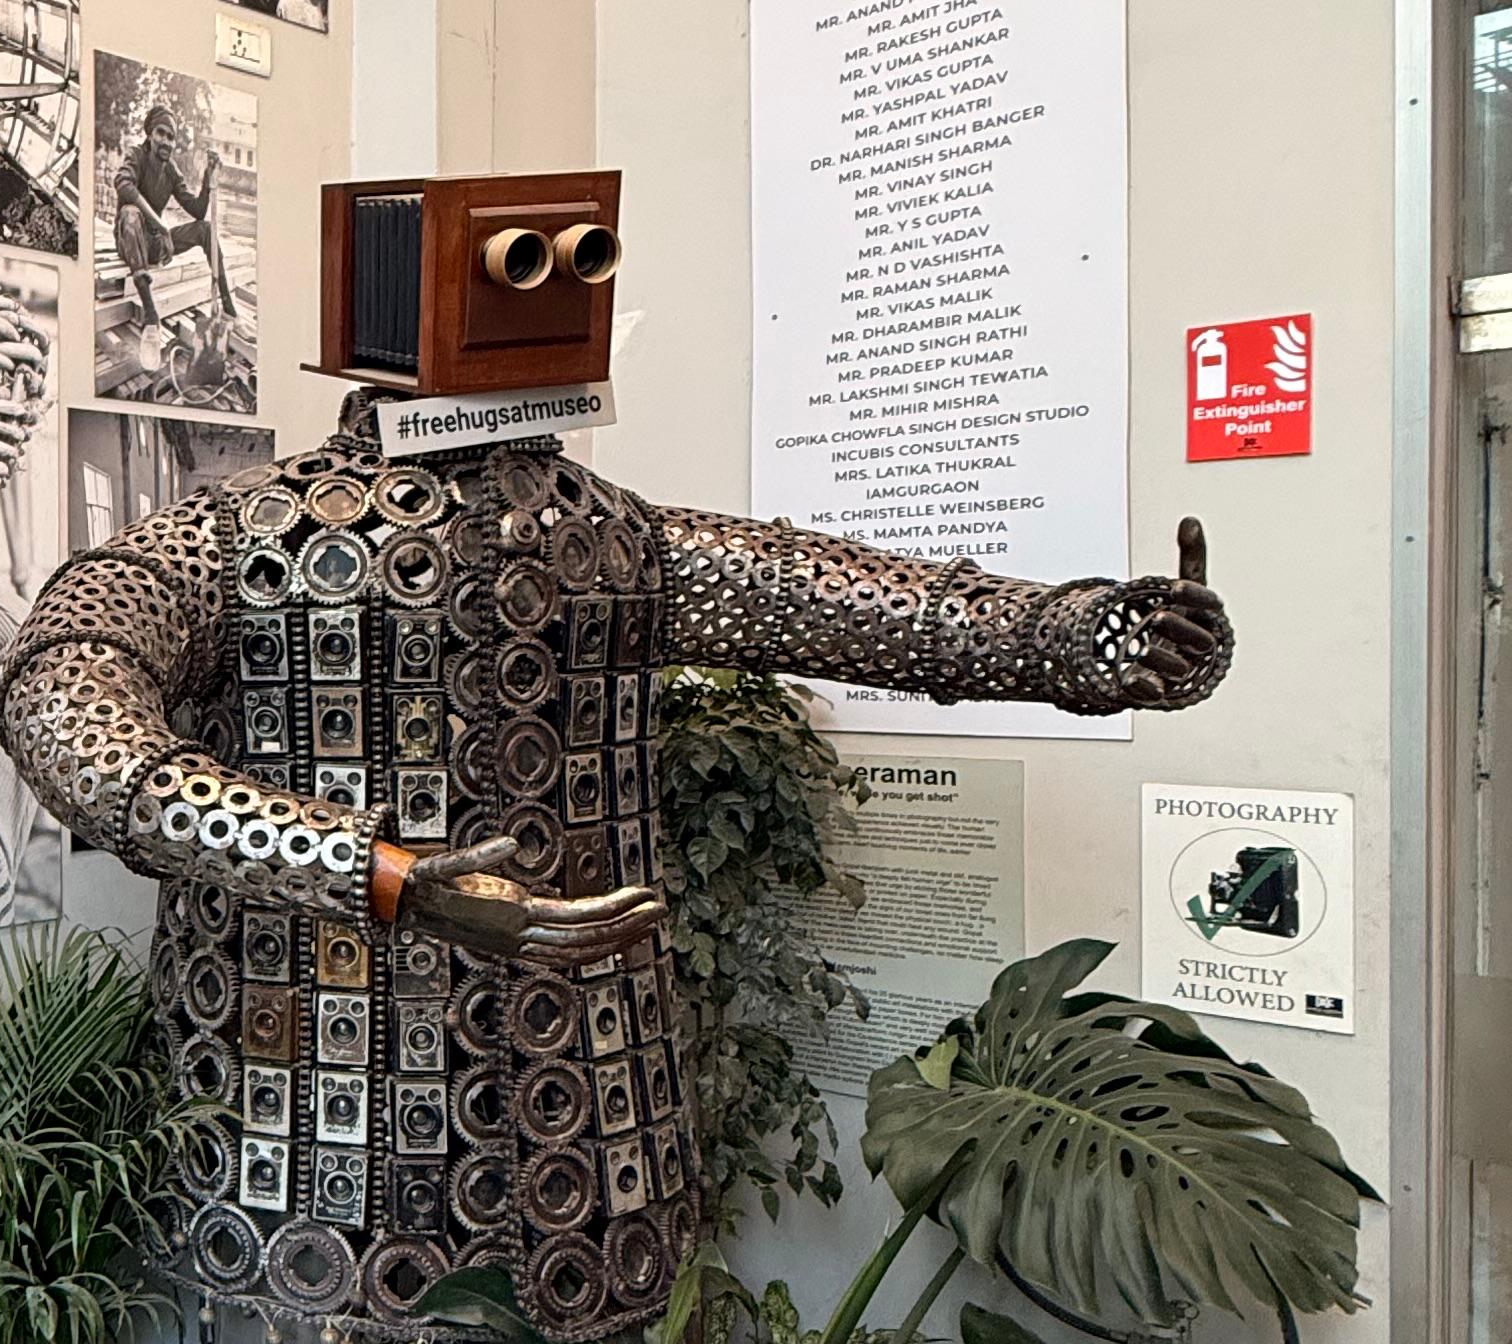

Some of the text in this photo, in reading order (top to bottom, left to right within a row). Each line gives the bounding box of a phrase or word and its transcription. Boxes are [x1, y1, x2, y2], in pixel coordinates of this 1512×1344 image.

[815, 15, 844, 33] MR.
[844, 7, 1004, 64] MR. RAKESH GUPTA
[867, 19, 897, 37] MR.
[898, 4, 941, 28] AMIT
[839, 27, 1010, 85] MR. V UMA SHANKAR
[853, 53, 994, 101] MR. VIKAS GUPTA
[840, 69, 1009, 125] MR. YASHPAL YADAV
[854, 95, 992, 142] MR. AMIT KHATRI
[809, 104, 1045, 172] DR. NARHARI SINGH BANGER
[838, 134, 1013, 185] MR. MANISH SHARMA
[854, 159, 993, 201] MR. VINAY SINGH
[854, 181, 994, 221] MR. VIVIEK KALIA
[864, 205, 983, 240] MR. Y S GUPTA
[858, 223, 991, 261] MR. ANIL YADAV
[845, 243, 1005, 284] MR. N D VASHISHTA
[840, 264, 1011, 304] MR. RAMAN SHARMA
[855, 287, 994, 321] MR. VIKAS MALIK
[831, 304, 1023, 345] MR. DHARAMBIR MALIK
[825, 325, 1028, 366] MR. ANAND SINGH RATHI
[838, 348, 1014, 384] MR. PRADEEP KUMAR
[808, 365, 1049, 407] MR. LAKSHMI SINGH TEWATIA
[1231, 383, 1266, 399] Fire
[397, 394, 601, 440] #freehugsatmuseo
[849, 393, 1000, 422] MR. MIHIR MISHRA
[1193, 399, 1307, 421] Extinguisher
[774, 404, 1090, 449] GOPIKA CHOWFLA SINGH DESIGN STUDIO
[1225, 420, 1273, 436] Point
[831, 433, 1020, 463] INCUBIS CONSULTANTS
[834, 455, 1017, 483] MRS. LATIKA THUKRAL
[866, 479, 980, 501] IAMGURGAON
[810, 495, 1045, 524] MS. CHRISTELLE WEINSBERG
[873, 525, 933, 540] MAMTA
[937, 521, 1008, 536] PANDYA
[929, 542, 1008, 557] MUELLER
[846, 690, 883, 702] MRS.
[882, 792, 903, 801] you
[906, 792, 924, 802] get
[1154, 798, 1338, 826] PHOTOGRAPHY
[1179, 959, 1288, 987] STRICTLY
[1172, 982, 1295, 1013] ALLOWED
